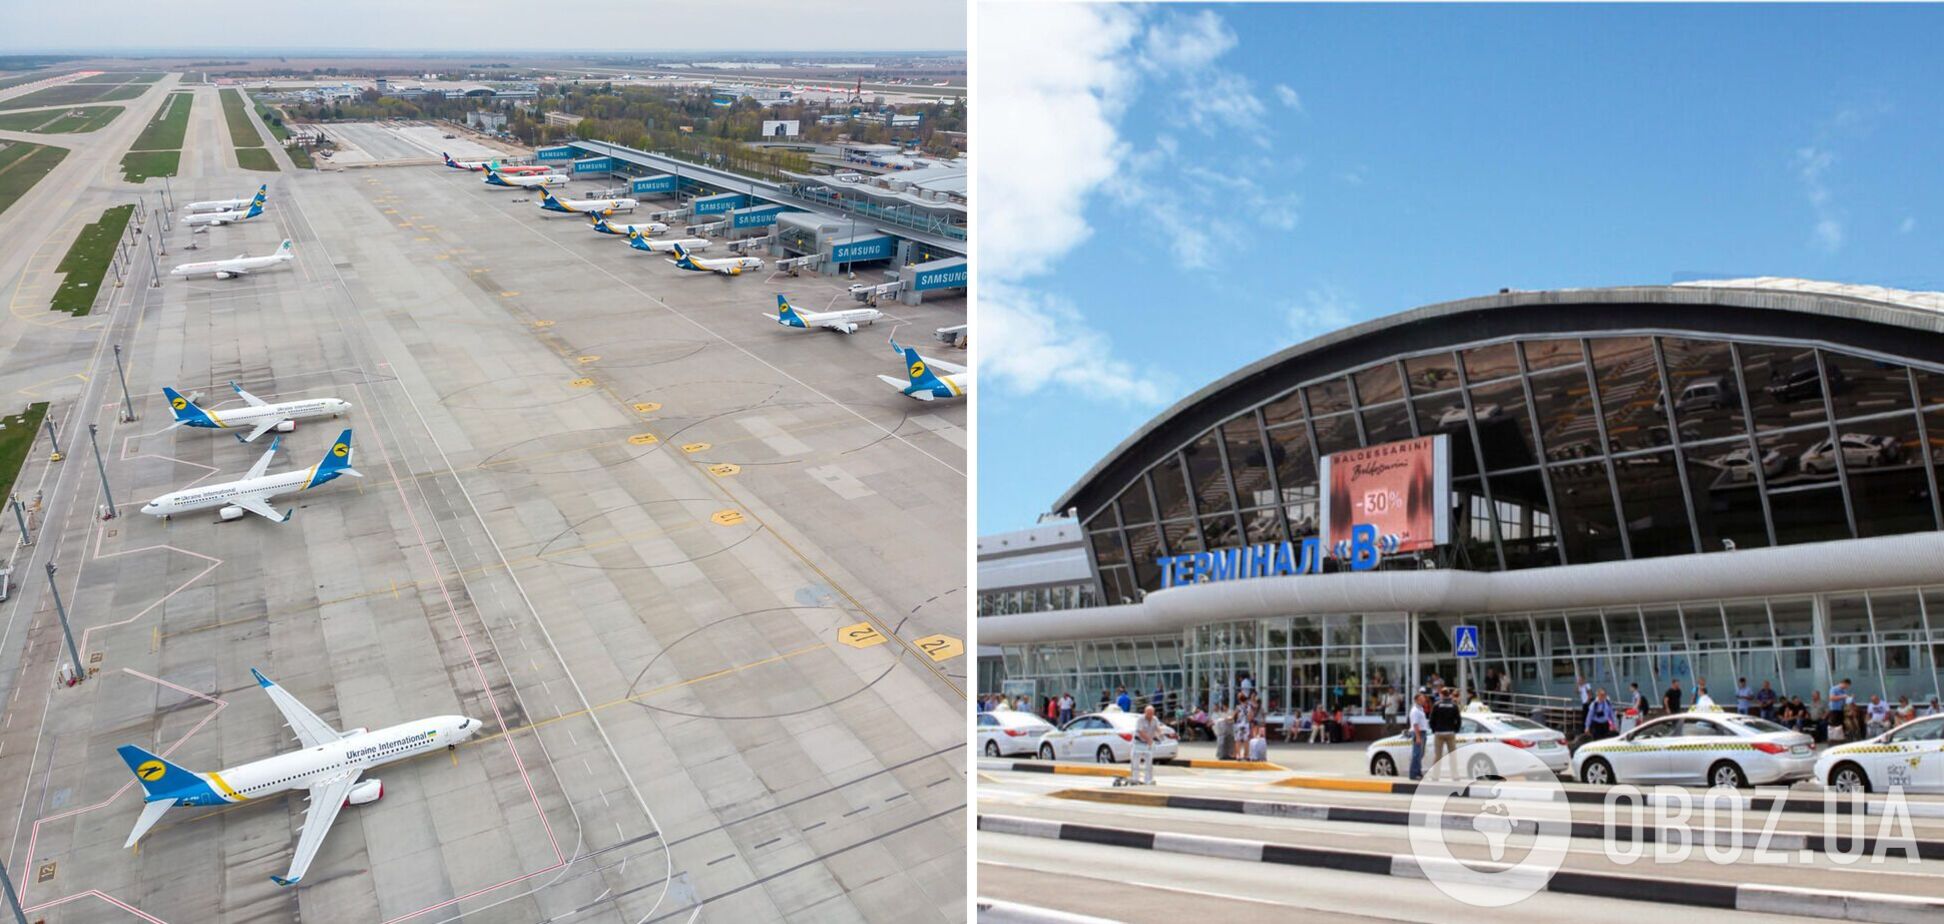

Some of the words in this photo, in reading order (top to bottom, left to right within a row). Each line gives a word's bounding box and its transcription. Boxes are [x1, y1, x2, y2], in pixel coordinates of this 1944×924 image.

[637, 182, 670, 190] SAMSUNG
[700, 202, 736, 211] SAMSUNG
[838, 245, 880, 257] SAMSUNG
[921, 271, 967, 285] SAMSUNG
[1333, 441, 1428, 464] BALDESSARINI
[1156, 537, 1324, 589] ТЕРМІНАЛ
[346, 746, 377, 760] Ukraine
[379, 731, 427, 751] International
